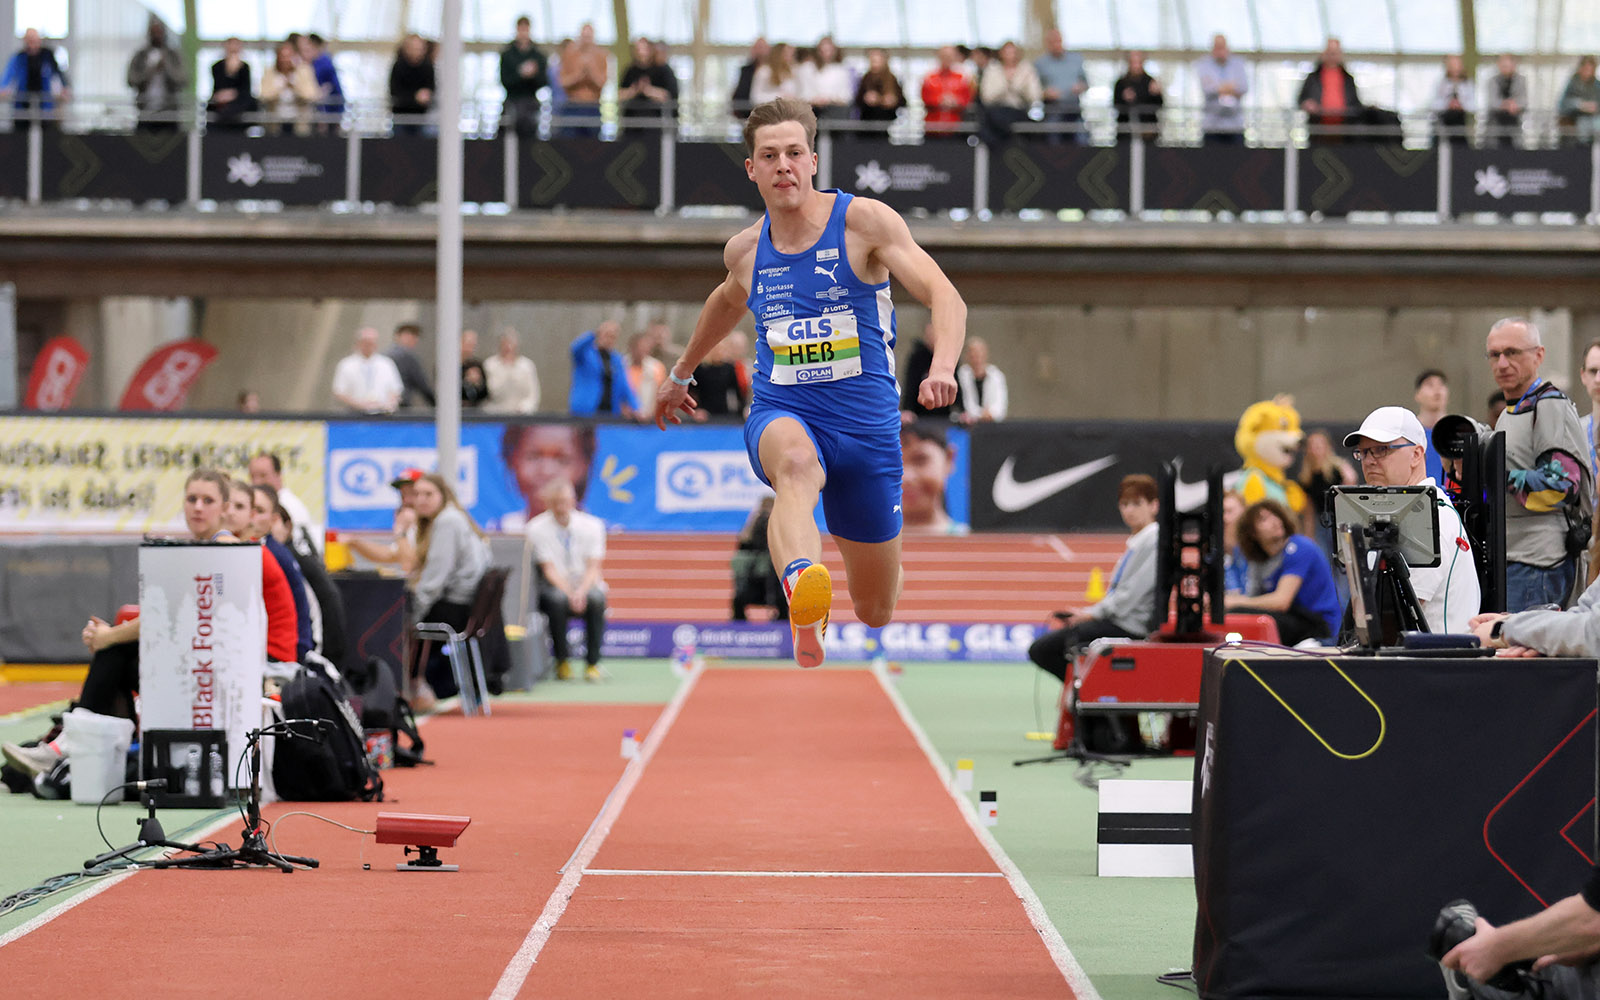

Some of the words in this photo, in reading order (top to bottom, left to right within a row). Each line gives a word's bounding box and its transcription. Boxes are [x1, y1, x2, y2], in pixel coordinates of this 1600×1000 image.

[765, 283, 794, 293] Sparkasse
[765, 291, 792, 301] Chemnitz
[766, 303, 784, 312] Radio
[830, 304, 849, 312] LOTTO
[811, 368, 832, 377] PLAN
[192, 573, 213, 651] Forest
[192, 659, 213, 729] Black
